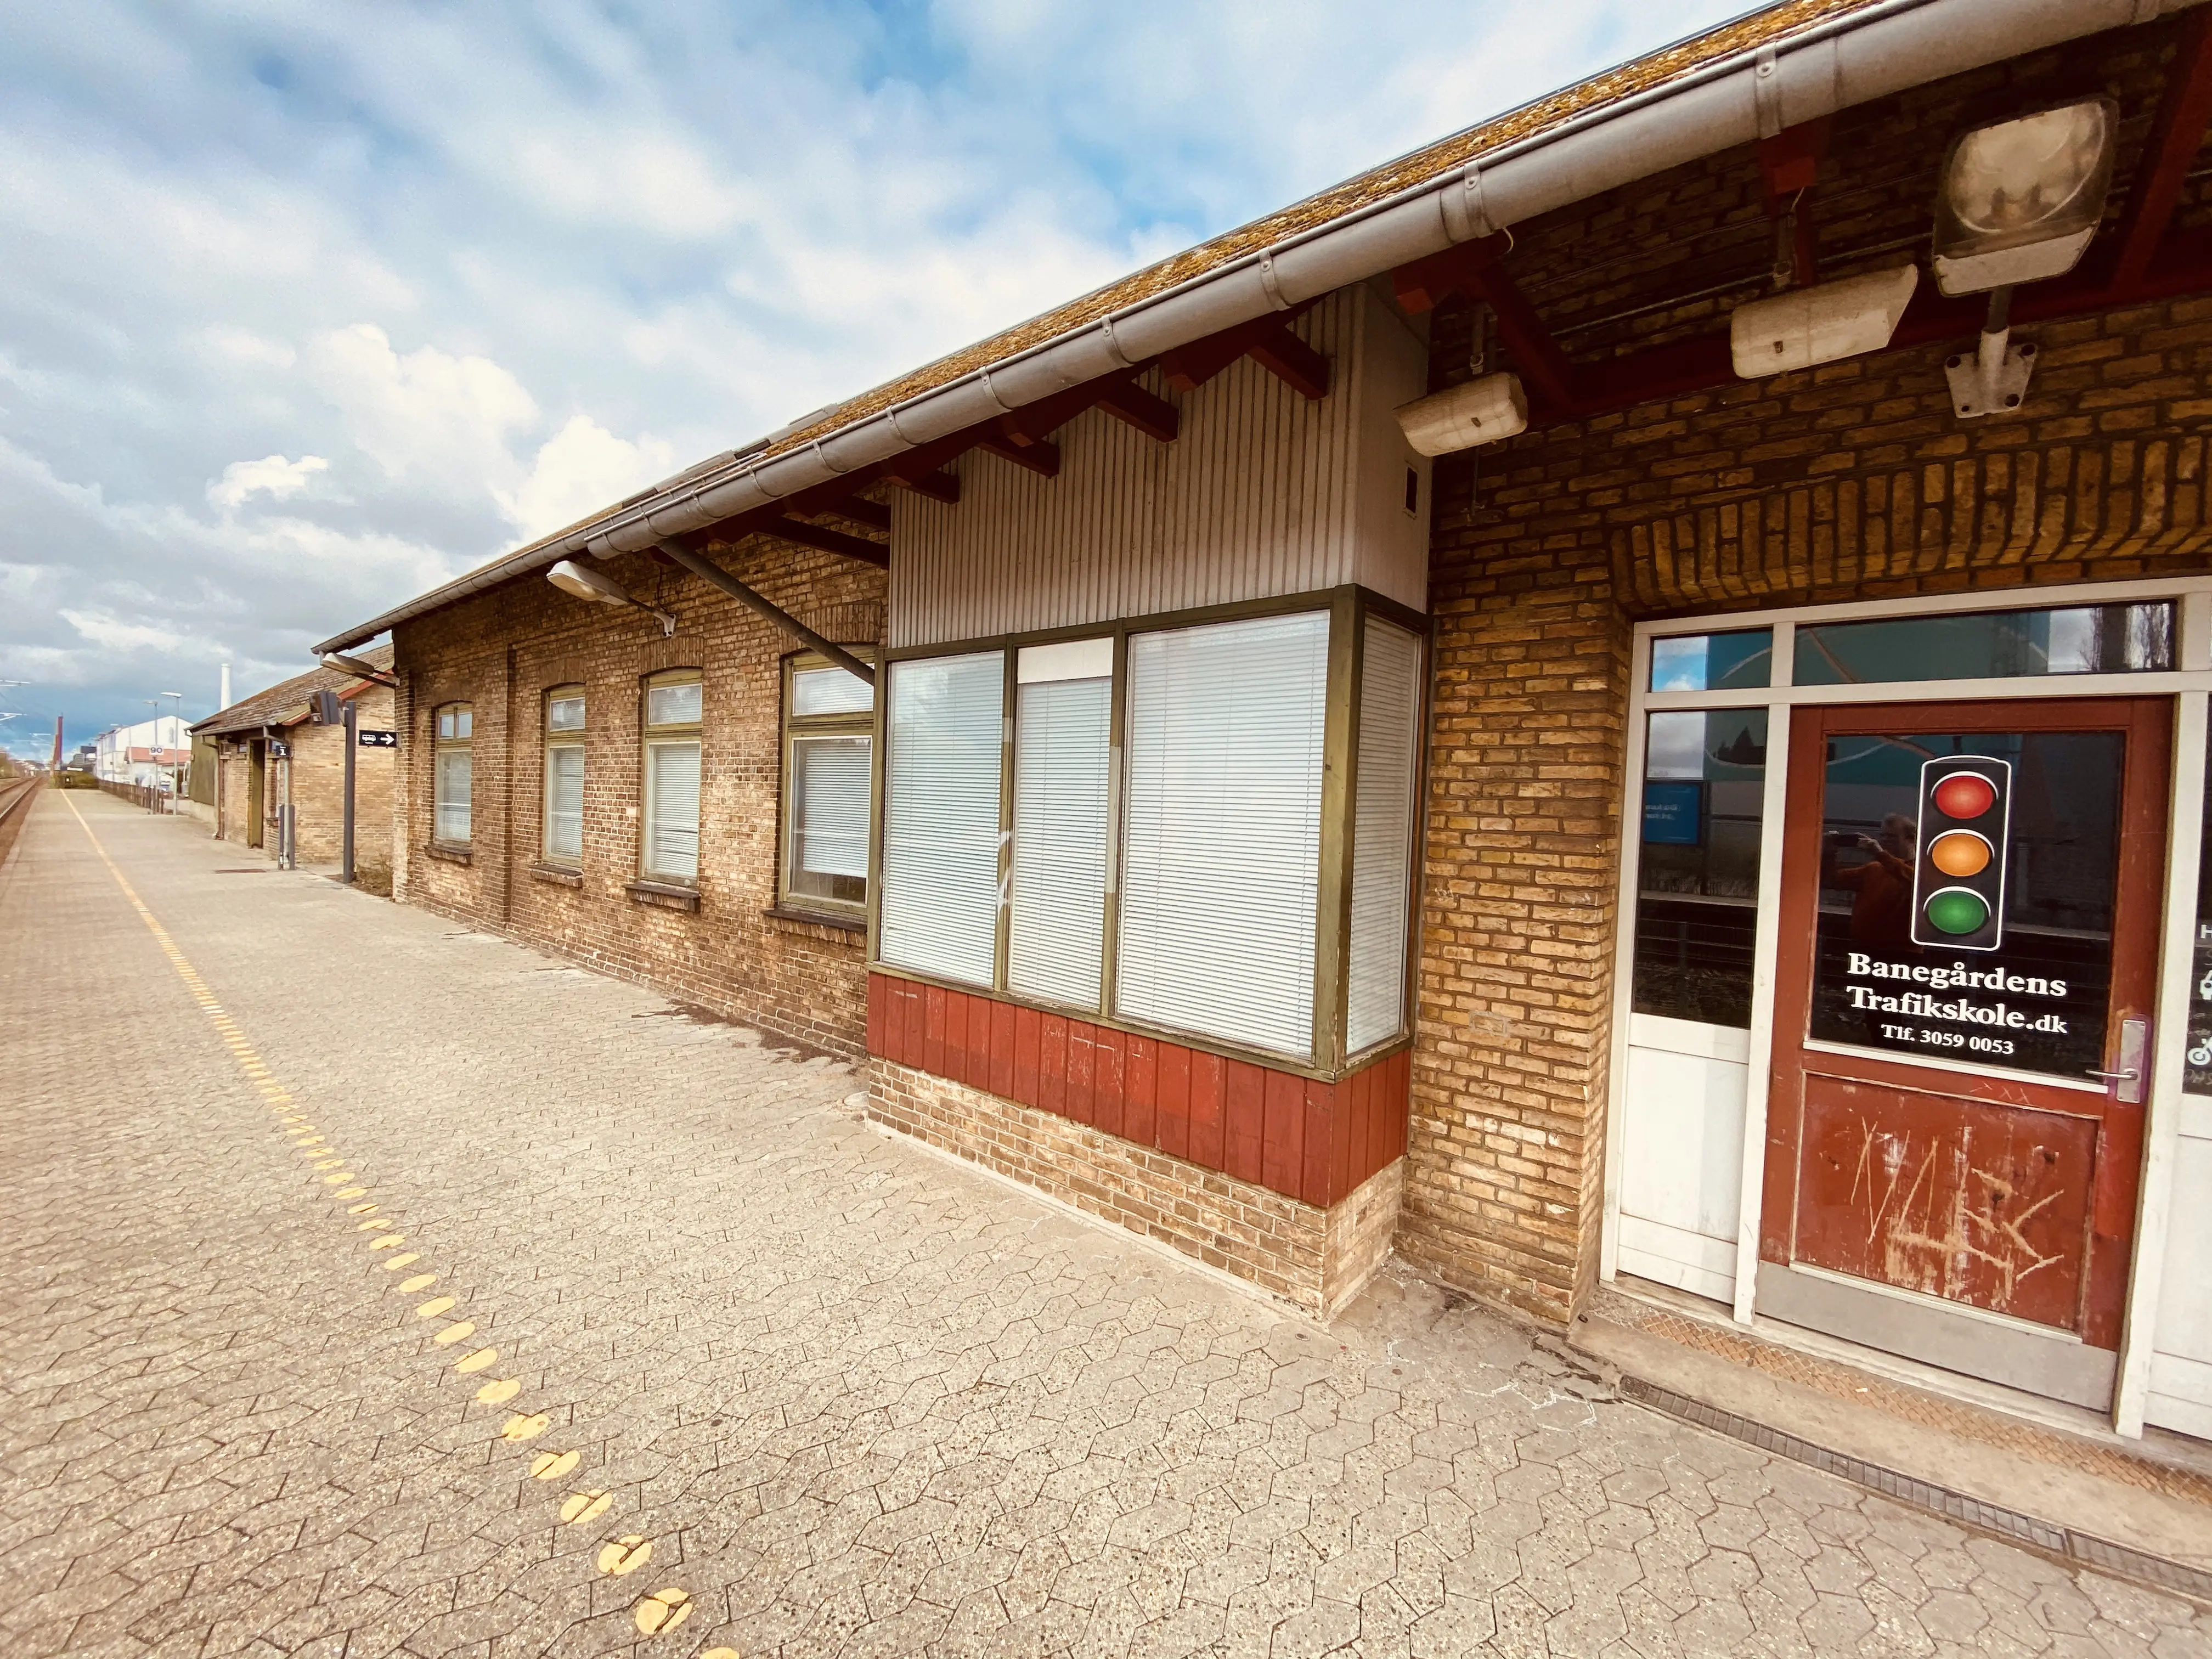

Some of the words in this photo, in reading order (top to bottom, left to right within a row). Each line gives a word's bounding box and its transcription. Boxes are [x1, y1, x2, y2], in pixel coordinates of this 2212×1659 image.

[1847, 952, 2067, 997] Banegårdens
[1846, 986, 2068, 1034] Trafikskole.dk
[1881, 1024, 1916, 1041] Tlf.
[1920, 1030, 1965, 1047] 3059
[1969, 1036, 2015, 1054] 0053
